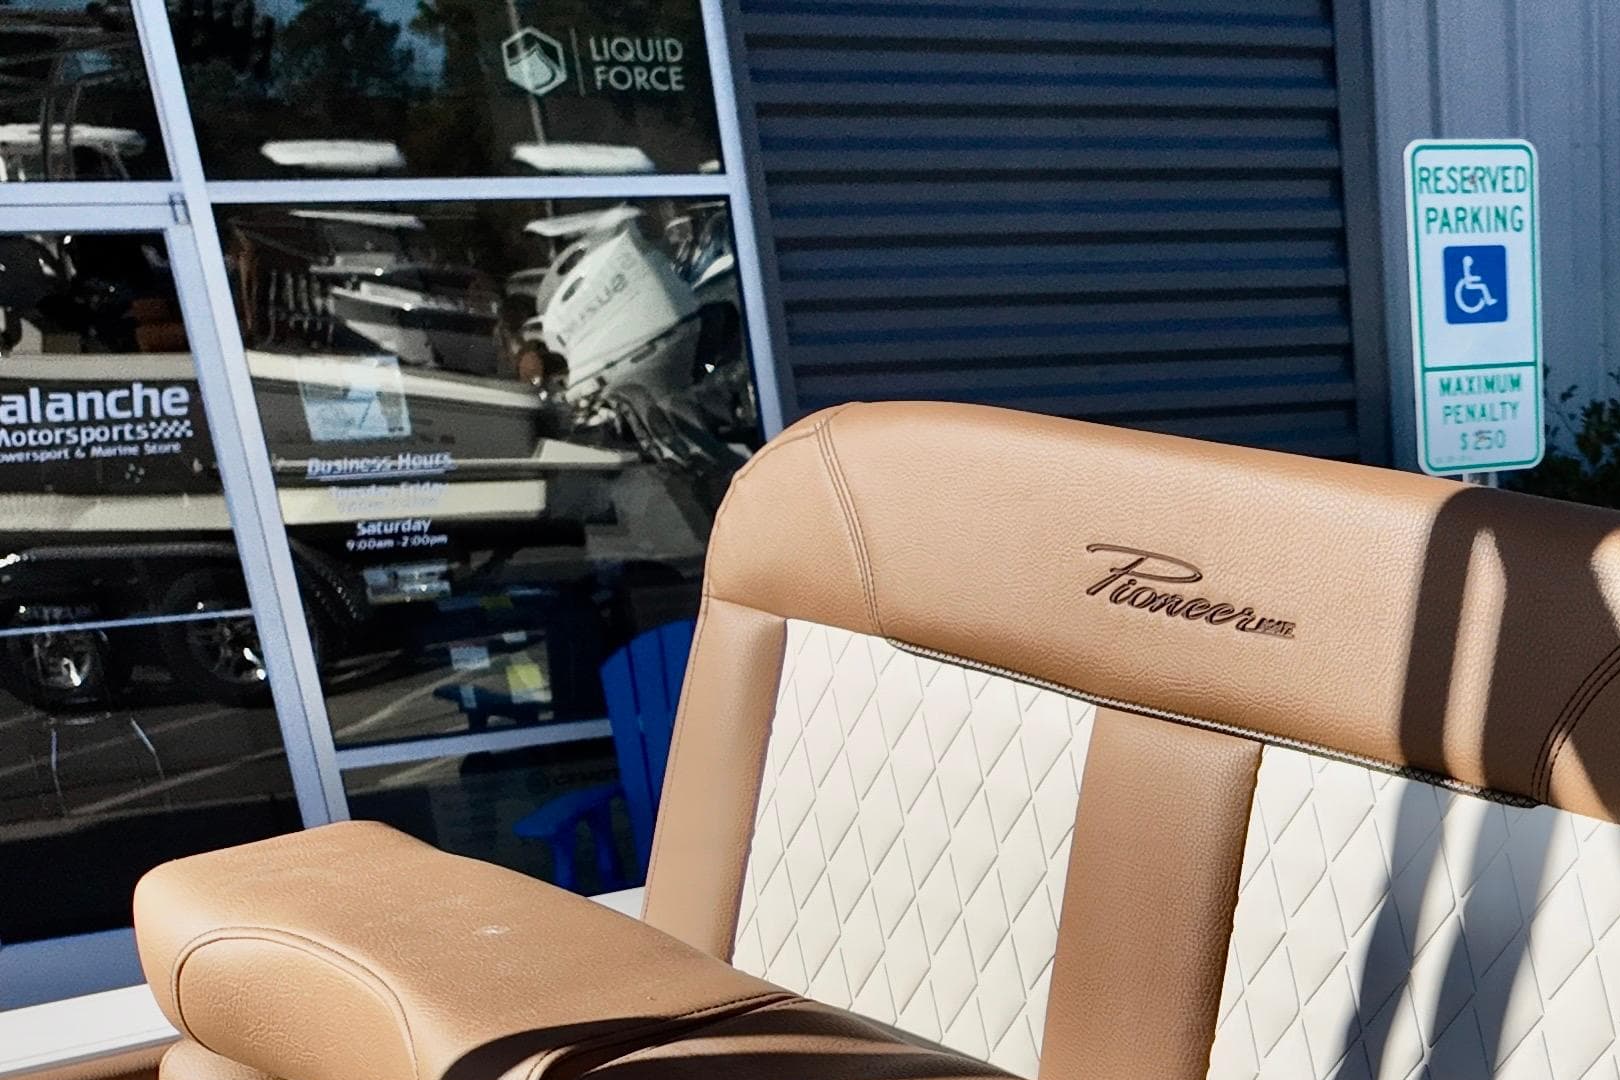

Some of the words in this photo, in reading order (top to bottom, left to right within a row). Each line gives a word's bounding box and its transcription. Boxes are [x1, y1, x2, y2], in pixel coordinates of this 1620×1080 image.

[588, 36, 684, 63] LIQUID
[593, 65, 686, 91] FORCE
[1418, 165, 1528, 194] RESERVED
[1424, 205, 1524, 234] PARKING
[1439, 373, 1522, 396] MAXIMUM
[1442, 401, 1520, 425] PENALTY
[74, 446, 87, 460] &
[90, 443, 140, 459] Marine
[143, 440, 182, 456] Store
[356, 517, 432, 537] Saturday
[1086, 542, 1257, 633] Pioneer
